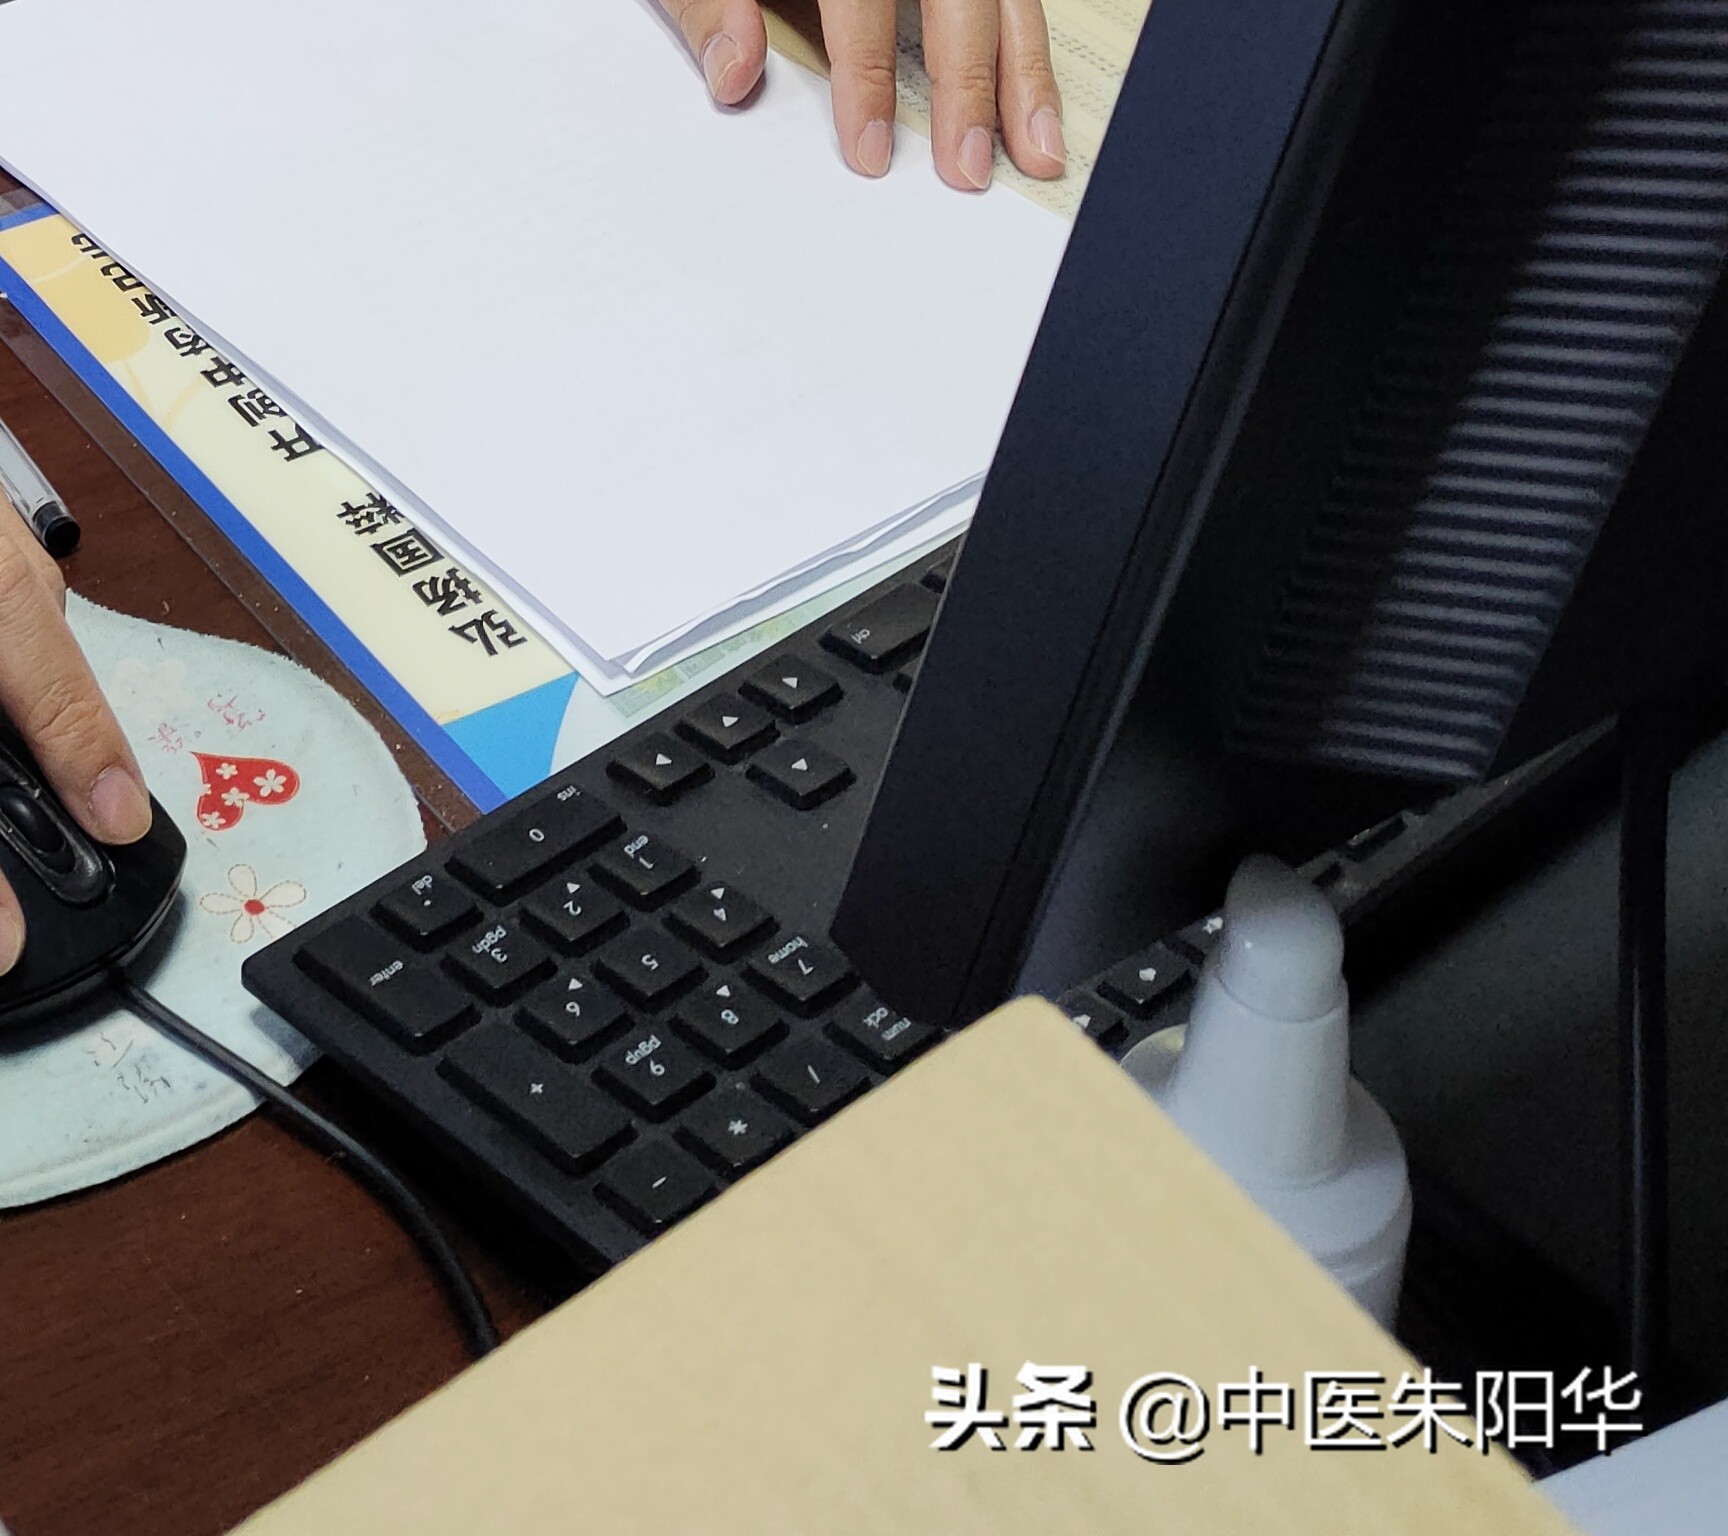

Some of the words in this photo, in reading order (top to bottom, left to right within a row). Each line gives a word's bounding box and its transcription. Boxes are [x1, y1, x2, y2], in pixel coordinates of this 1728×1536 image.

[334, 491, 528, 658] 弘扬国粹
[557, 785, 581, 801] ins
[529, 828, 545, 842] 0
[623, 835, 649, 862] end
[638, 857, 654, 869] 1
[411, 875, 433, 895] del
[563, 900, 582, 915] 2
[472, 925, 508, 958] pgdn
[485, 939, 508, 962] 3
[767, 936, 809, 970] home
[641, 954, 659, 971] 5
[797, 958, 814, 975] 7
[369, 960, 404, 986] enter
[565, 1001, 581, 1017] 6
[720, 1009, 739, 1025] 8
[625, 1034, 665, 1070] pgup
[649, 1059, 665, 1076] 9
